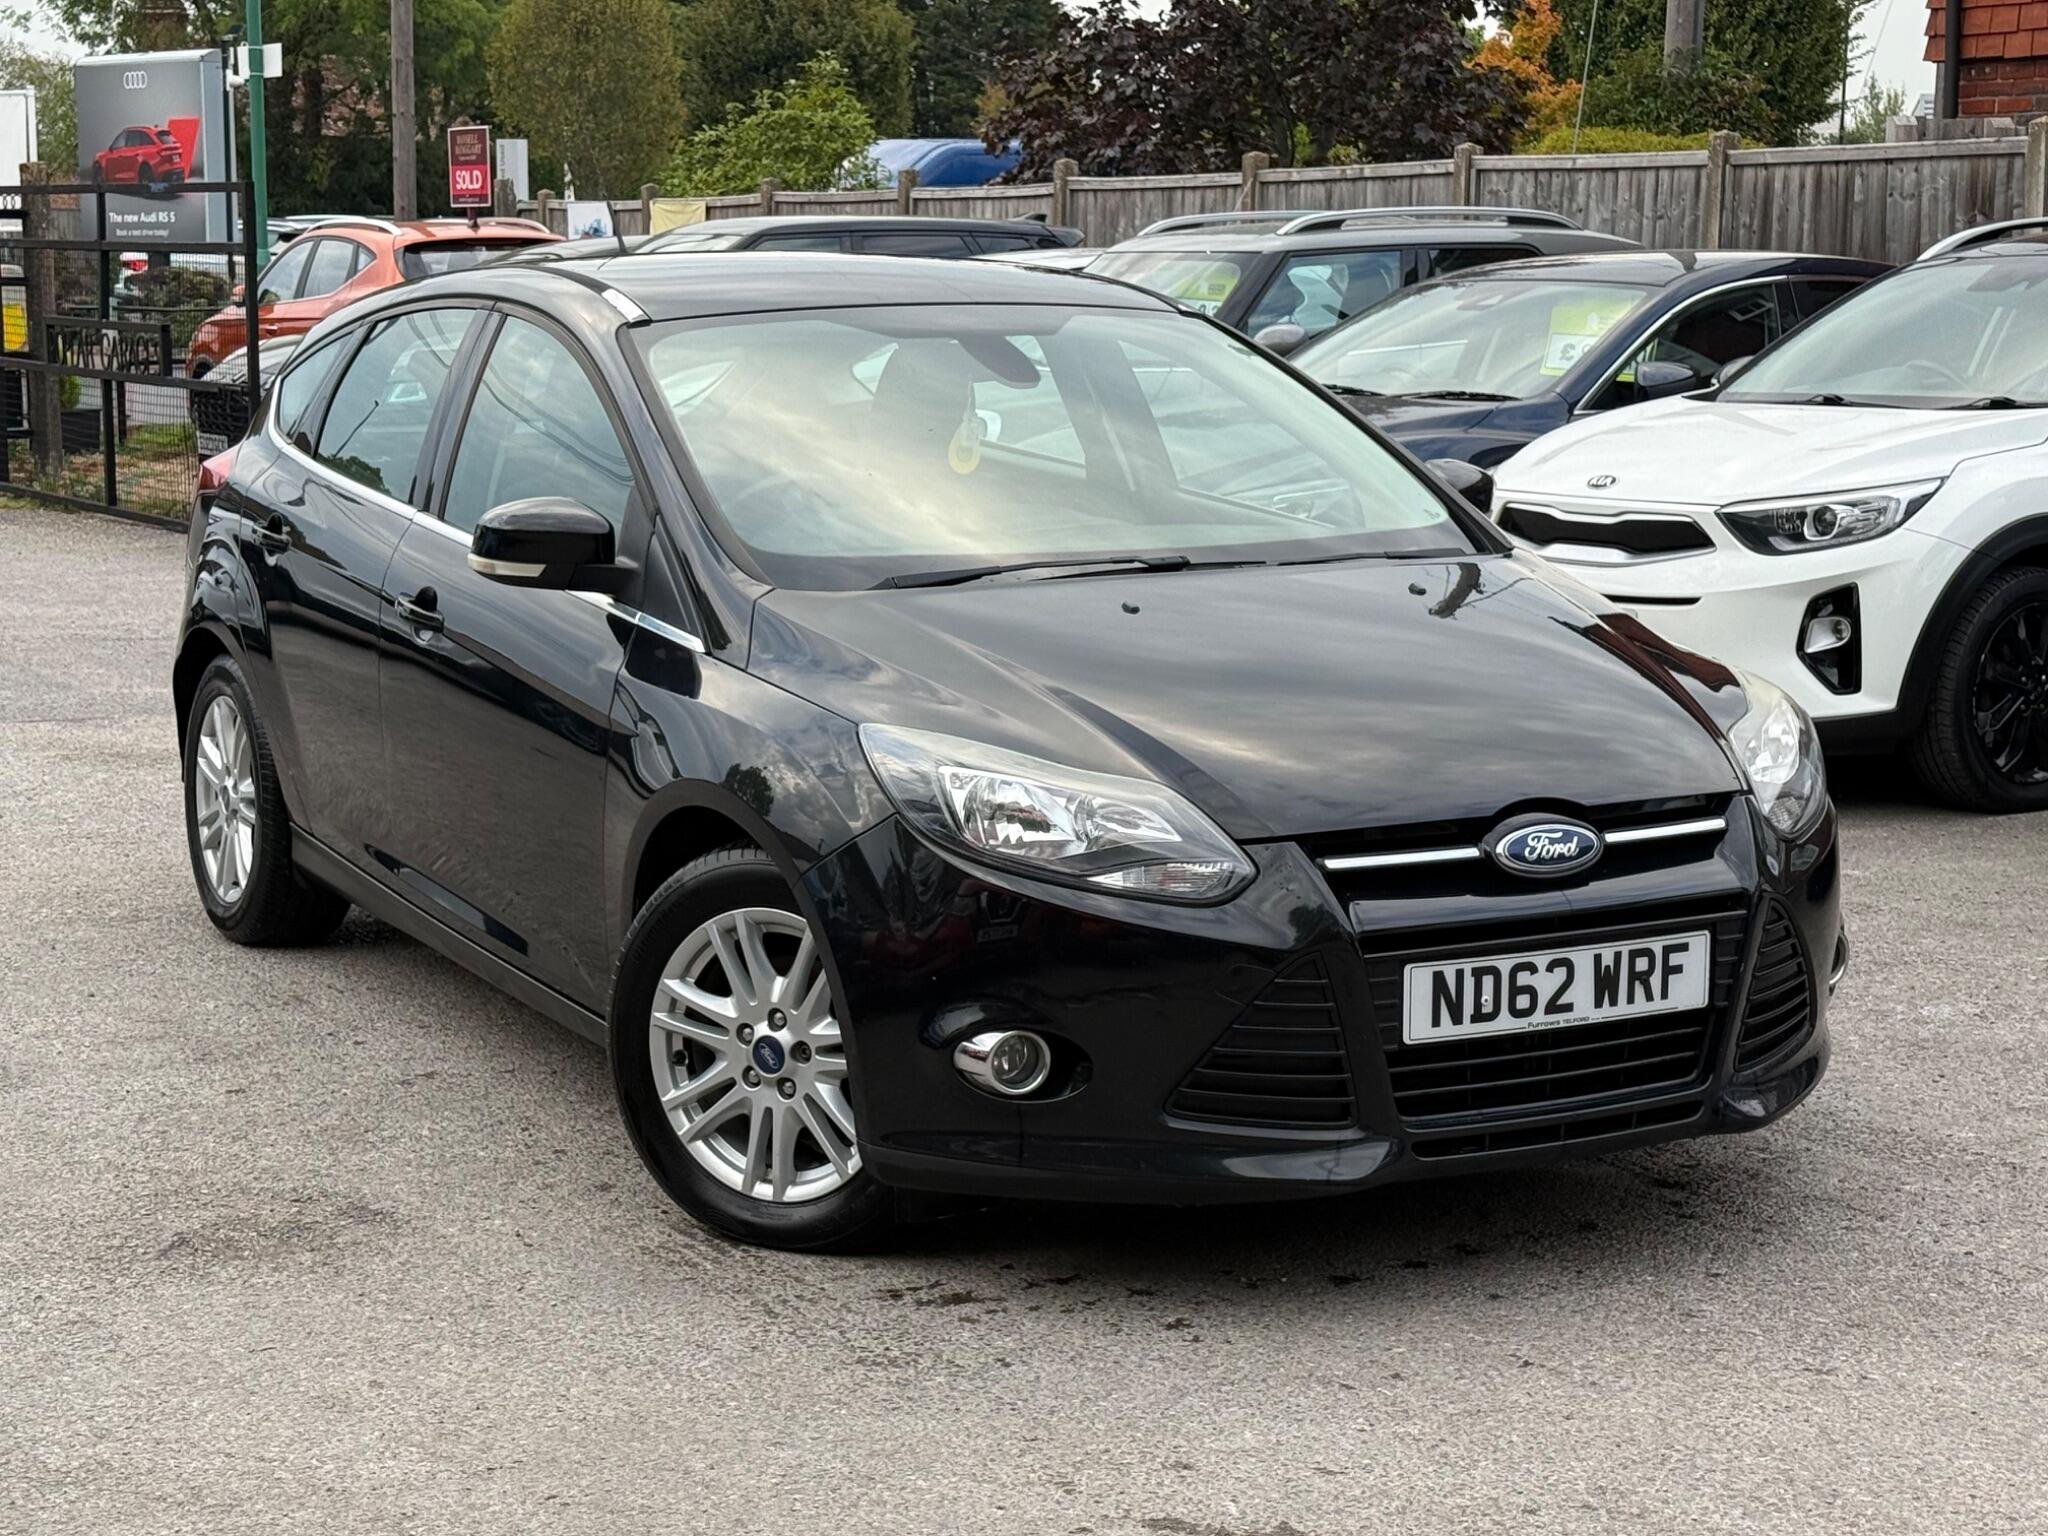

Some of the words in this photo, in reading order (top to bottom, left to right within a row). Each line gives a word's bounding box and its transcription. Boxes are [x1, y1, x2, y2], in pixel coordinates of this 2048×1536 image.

[455, 170, 483, 190] SOLD
[108, 212, 122, 223] The
[123, 214, 139, 223] new
[140, 211, 157, 222] Audi
[158, 211, 169, 222] RS
[1524, 831, 1580, 861] Ford
[1431, 957, 1576, 1029] ND62
[1593, 942, 1690, 1010] WRF
[1527, 1019, 1560, 1029] Furrows
[1562, 1016, 1590, 1025] TELFORD
